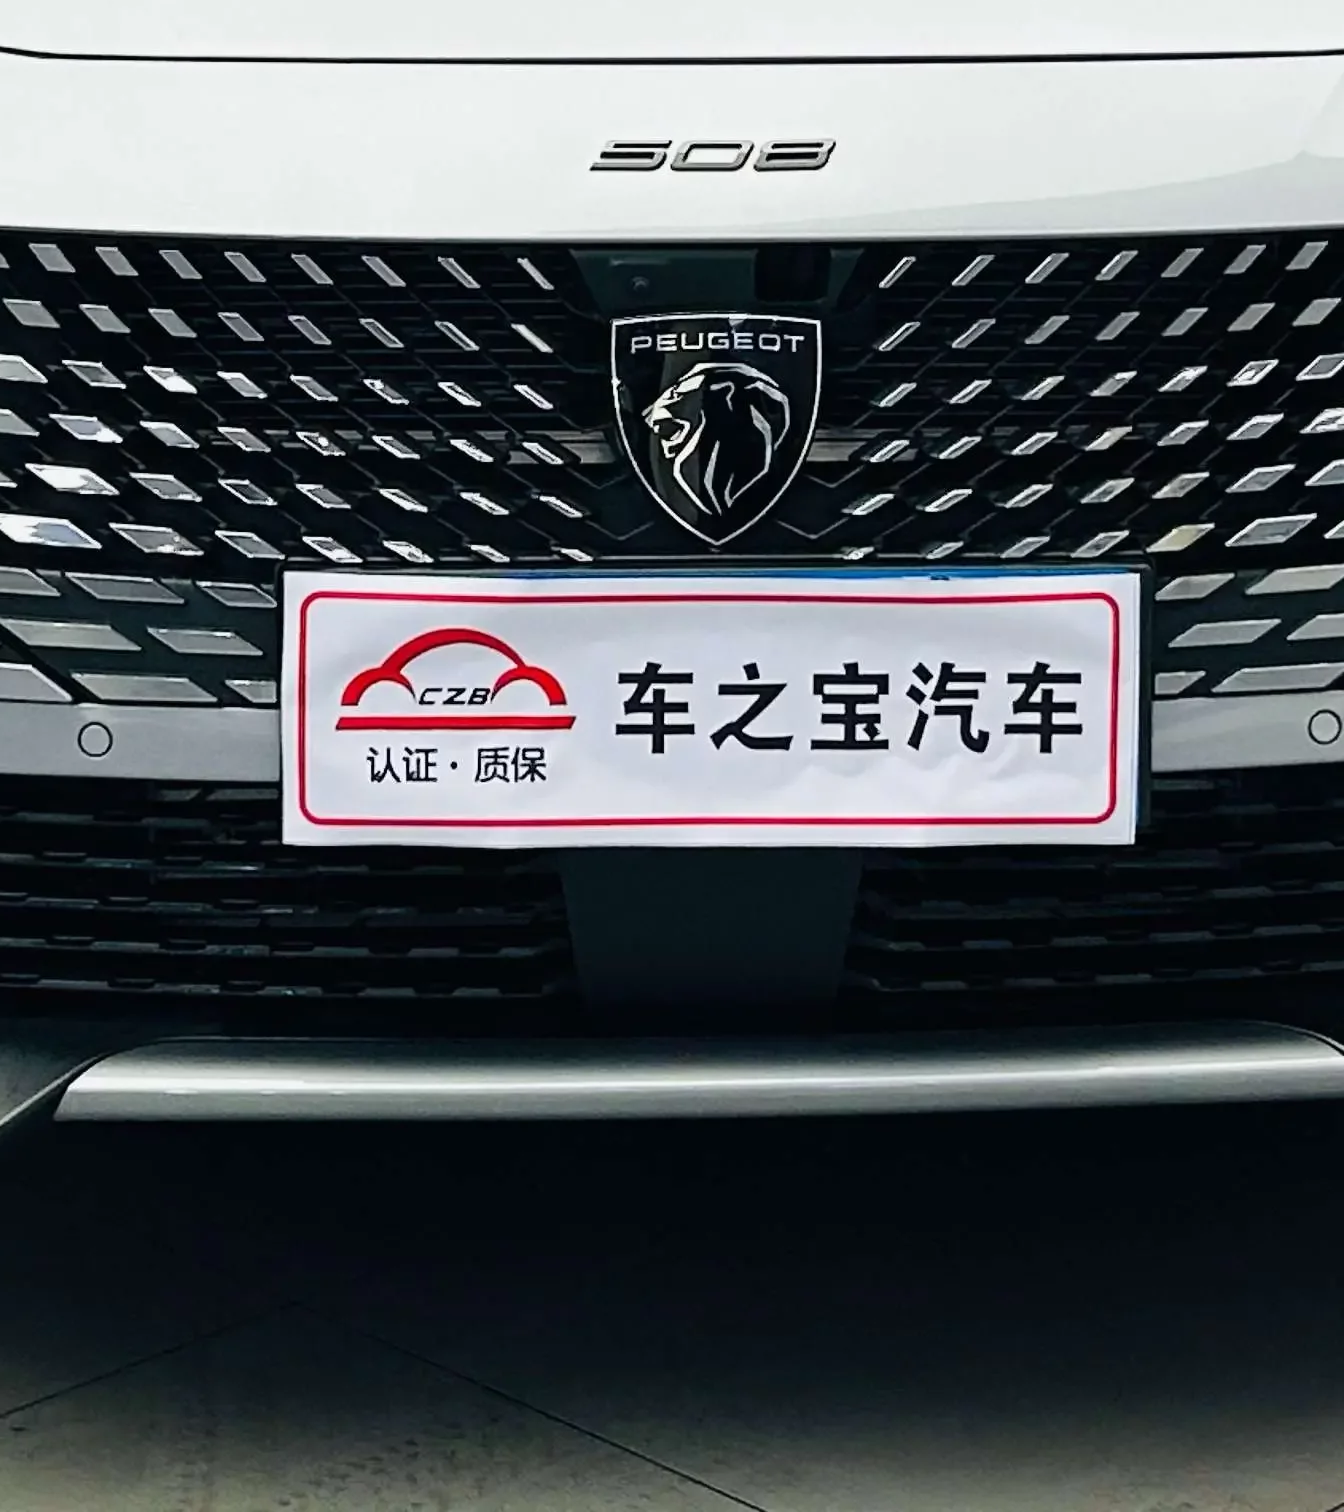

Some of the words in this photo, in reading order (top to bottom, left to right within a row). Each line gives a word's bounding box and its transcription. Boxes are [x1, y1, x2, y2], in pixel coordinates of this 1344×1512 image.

[589, 138, 837, 173] 508
[630, 330, 805, 354] PEUGEOT
[418, 687, 491, 706] CZB
[615, 661, 1083, 754] 车之宝汽车
[366, 746, 547, 783] 认证·质保
